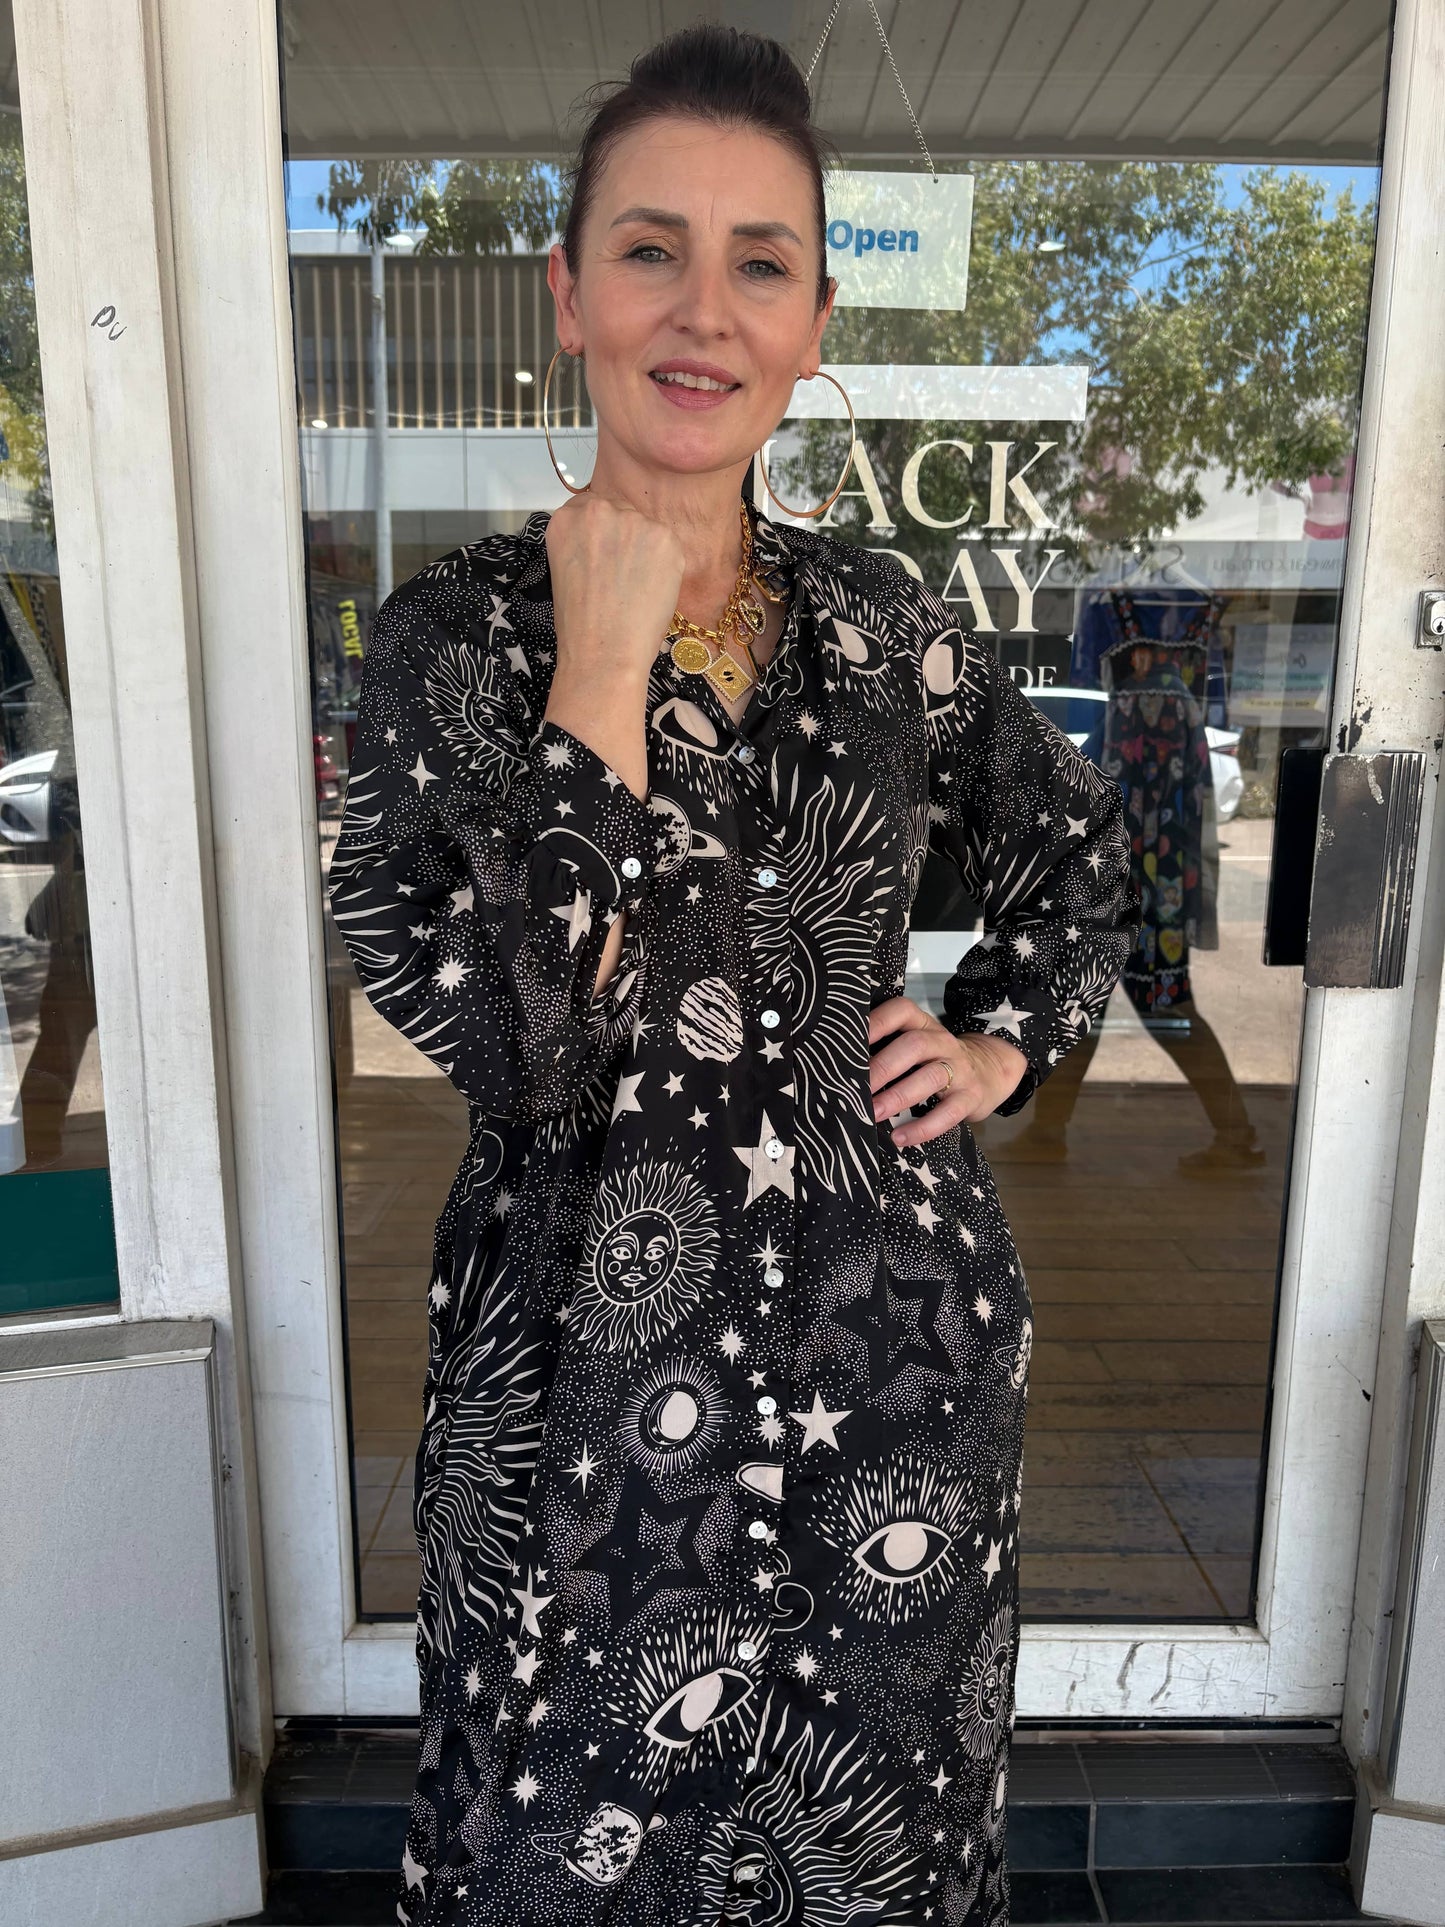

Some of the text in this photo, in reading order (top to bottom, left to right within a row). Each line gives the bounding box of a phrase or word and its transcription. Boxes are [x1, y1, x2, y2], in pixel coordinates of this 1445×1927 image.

[827, 219, 919, 258] Open
[753, 439, 1060, 530] LACK
[863, 548, 1065, 632] AY
[1008, 665, 1058, 689] DE
